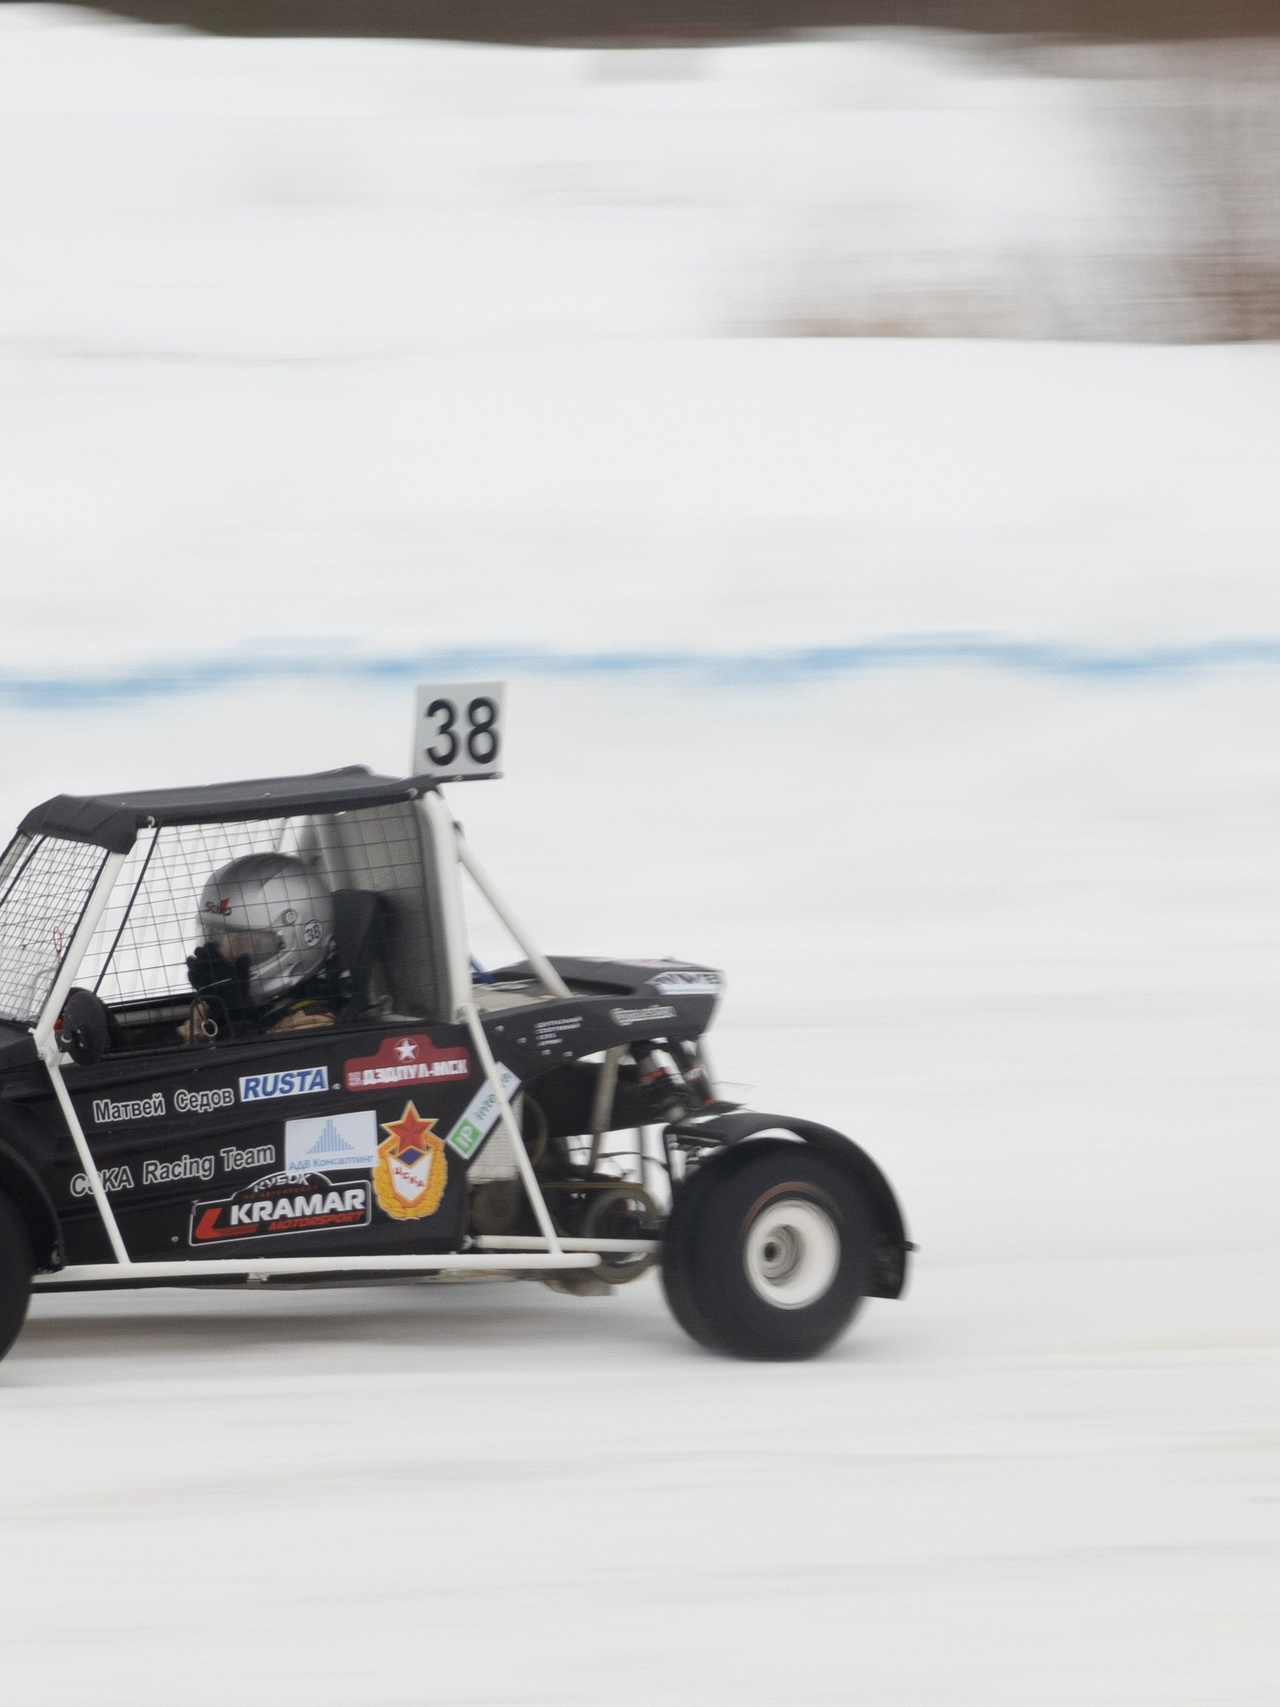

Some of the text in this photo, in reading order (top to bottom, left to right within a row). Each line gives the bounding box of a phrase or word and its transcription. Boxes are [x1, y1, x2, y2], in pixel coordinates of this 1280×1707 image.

[425, 697, 500, 766] 38
[243, 1069, 328, 1100] RUSTA
[93, 1088, 235, 1123] Матвей Седов
[143, 1155, 214, 1184] Racing
[221, 1145, 276, 1171] Team
[314, 1155, 374, 1169] Консалтинг
[230, 1188, 366, 1226] KRAMAR
[268, 1210, 365, 1231] MOTORSPORT
